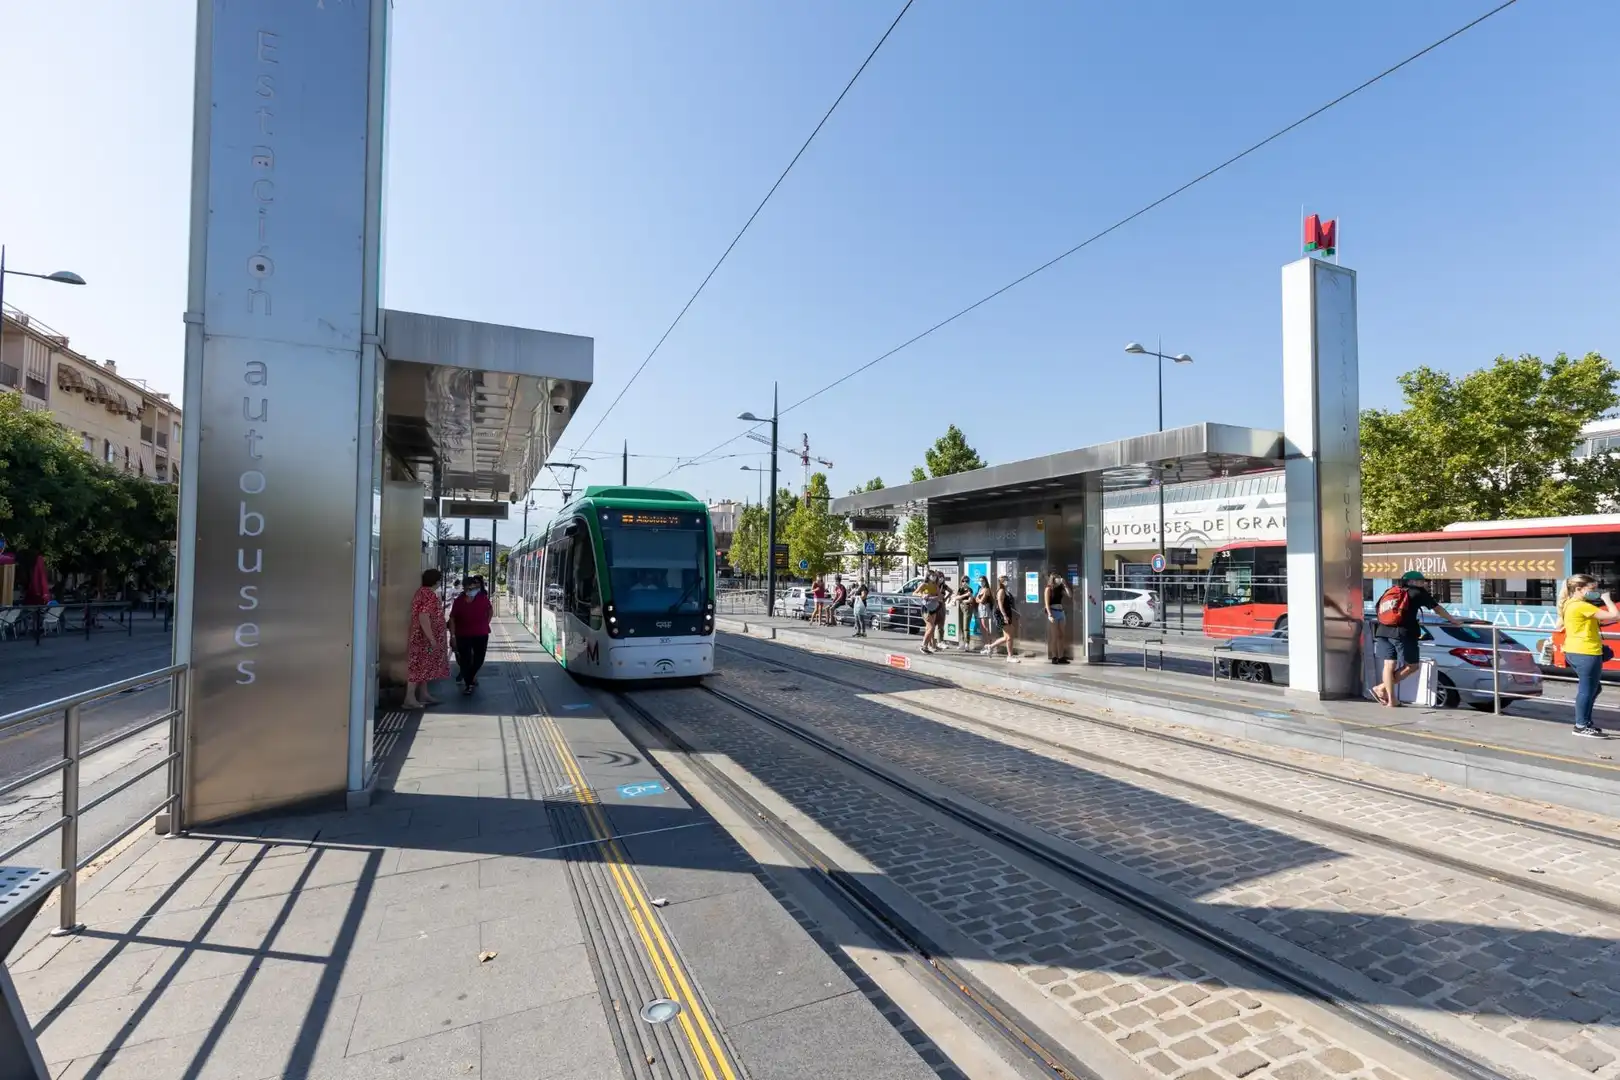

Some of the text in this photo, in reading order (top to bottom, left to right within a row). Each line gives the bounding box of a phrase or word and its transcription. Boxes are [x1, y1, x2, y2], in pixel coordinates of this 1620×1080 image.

[235, 360, 268, 685] autobuses
[1103, 520, 1192, 536] AUTOBUSES
[1203, 518, 1225, 532] DE
[1404, 557, 1448, 573] LA PEPITA
